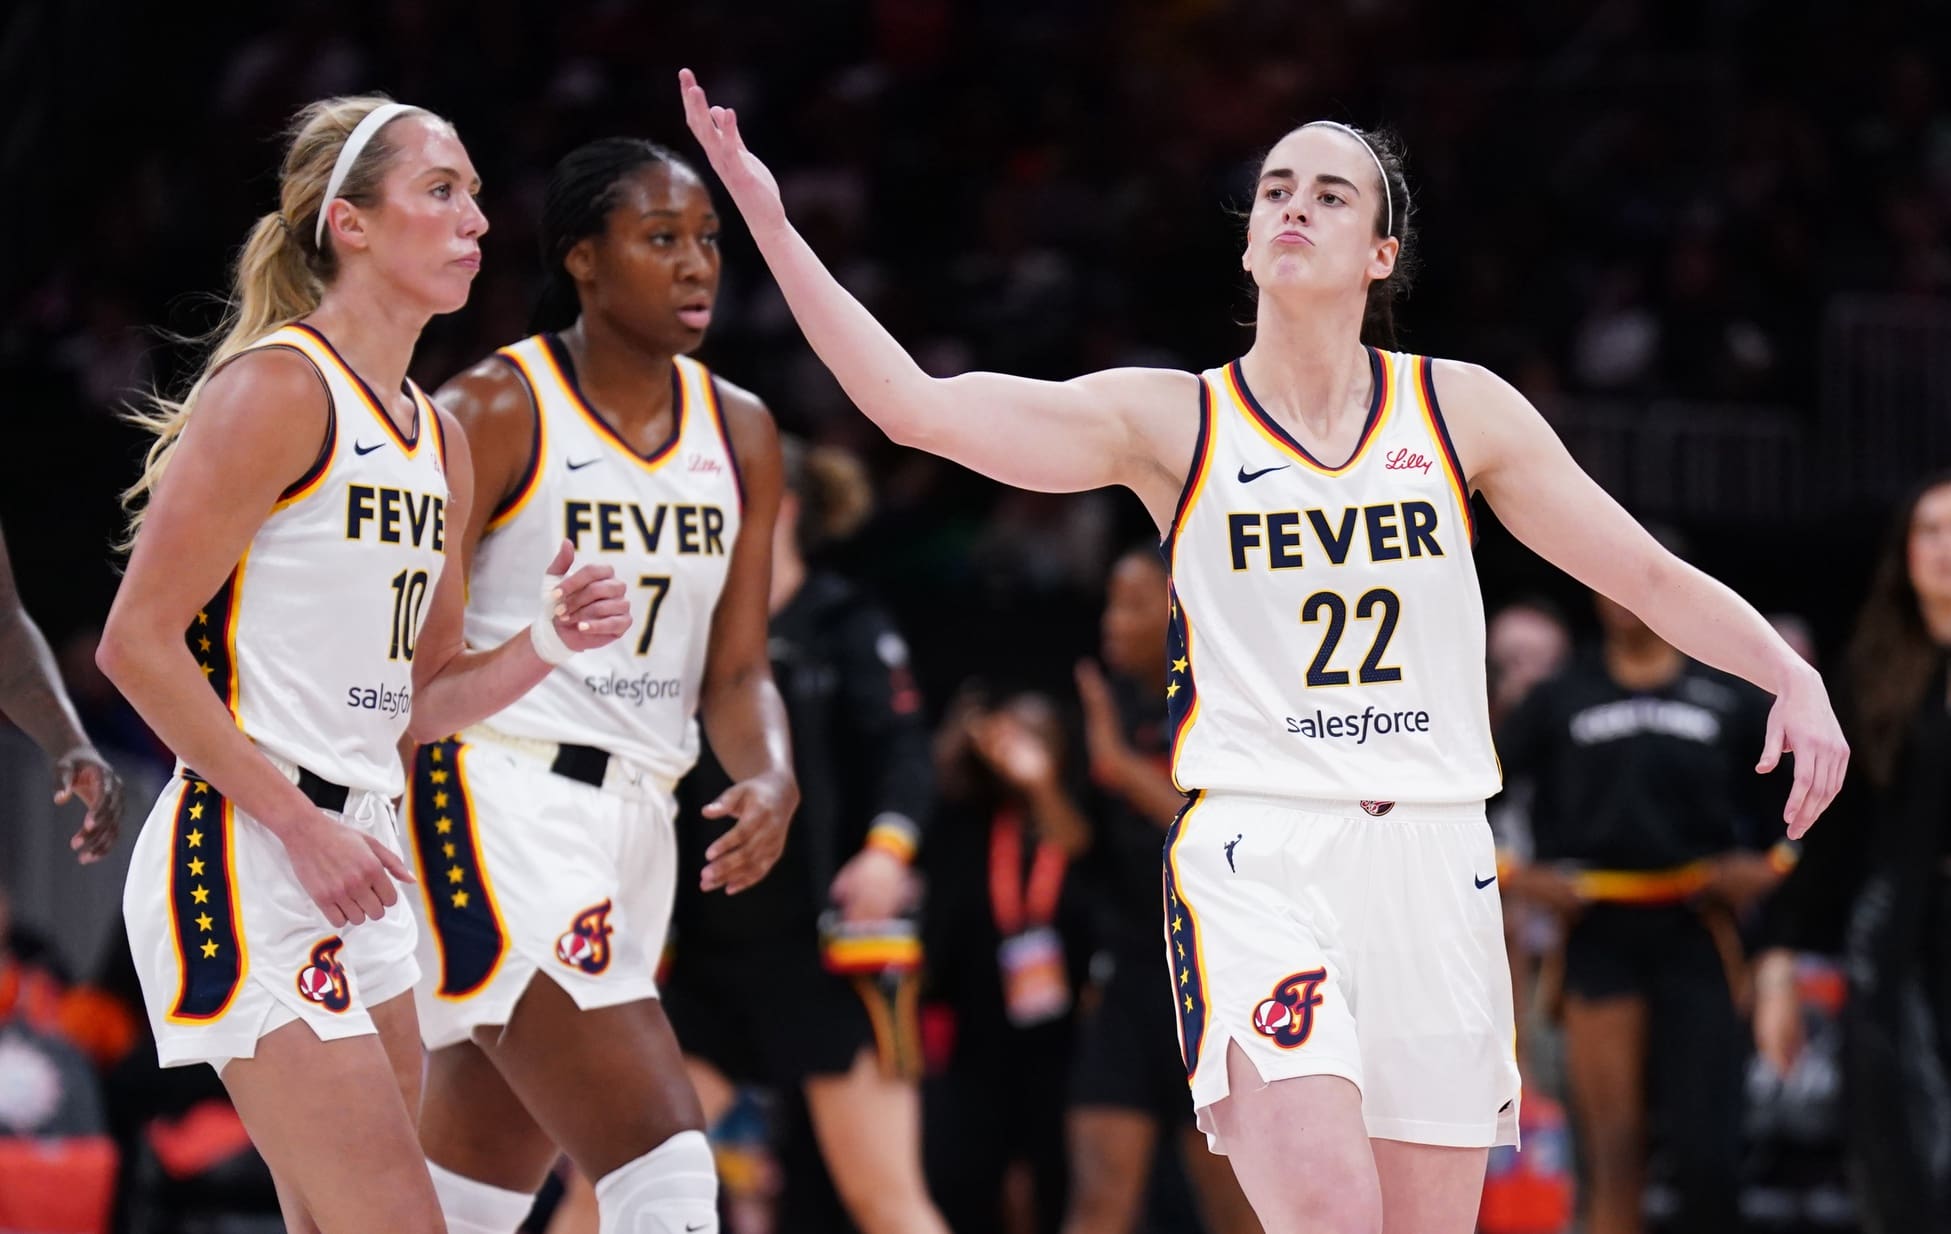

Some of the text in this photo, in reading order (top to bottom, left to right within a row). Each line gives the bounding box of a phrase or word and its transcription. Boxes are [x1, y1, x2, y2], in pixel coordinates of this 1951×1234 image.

[1385, 448, 1433, 475] Lilly
[346, 482, 446, 554] FEVE
[563, 499, 726, 556] FEVER
[1226, 500, 1447, 572] FEVER
[388, 567, 429, 662] 10
[635, 573, 672, 656] 7
[1299, 585, 1403, 689] 22
[1285, 706, 1430, 744] salesforce
